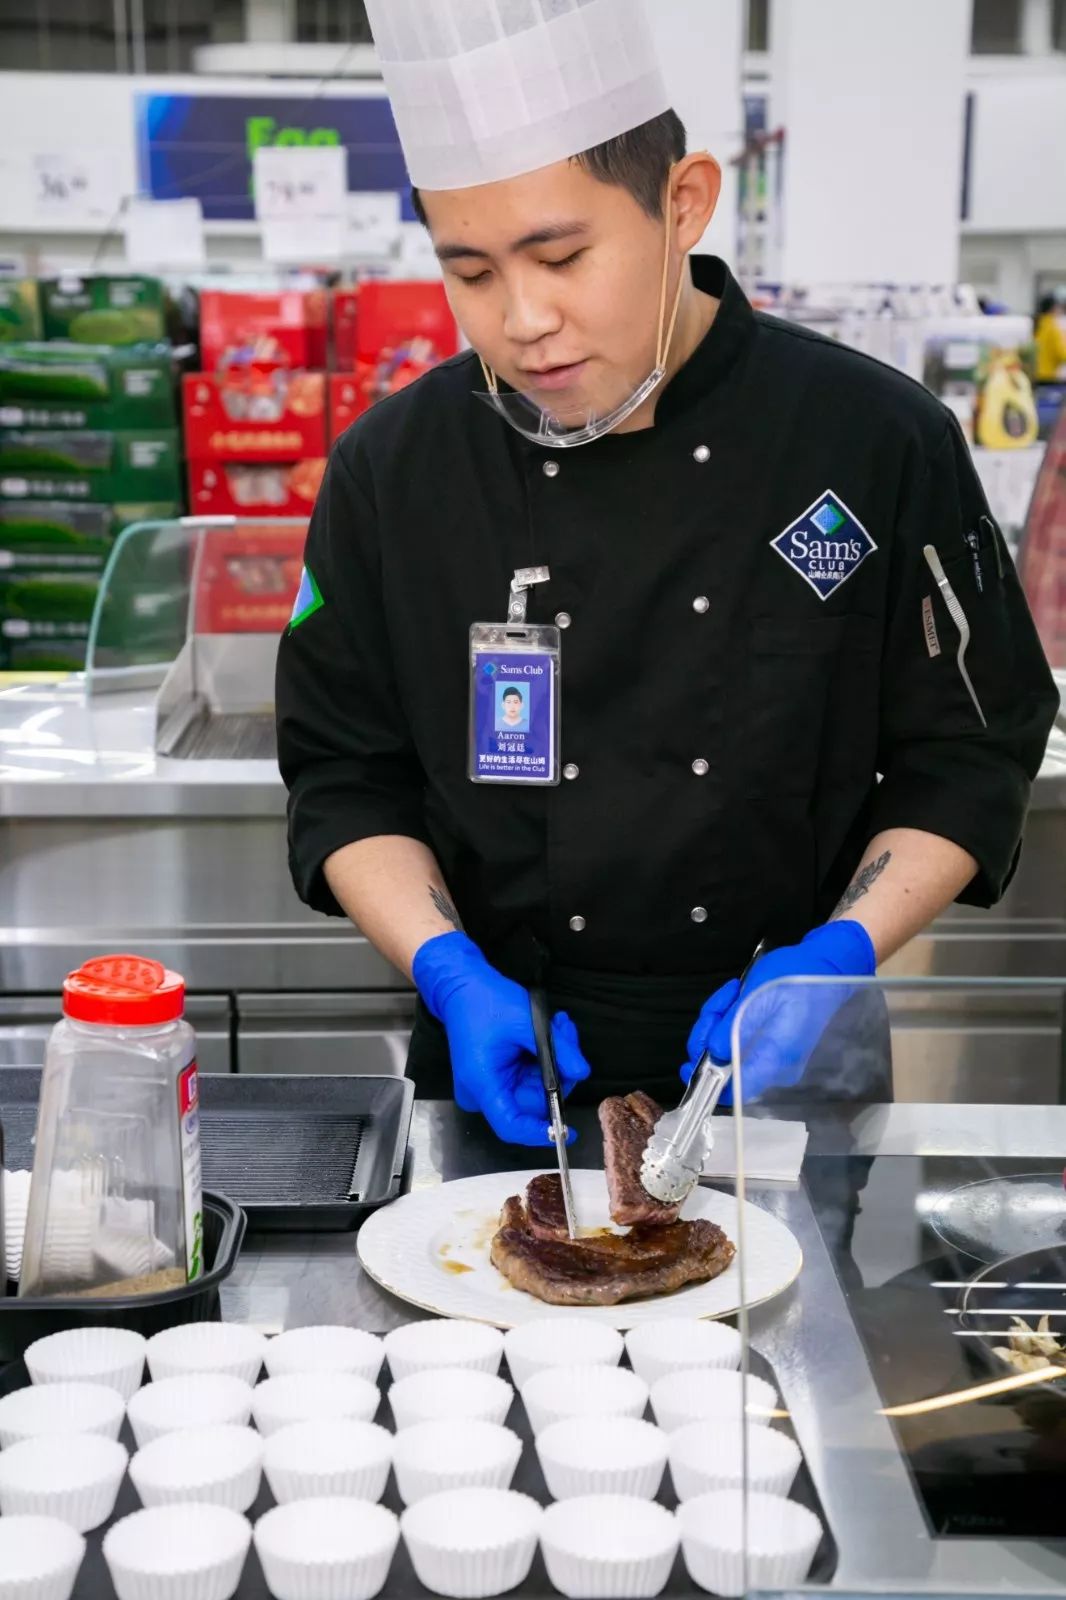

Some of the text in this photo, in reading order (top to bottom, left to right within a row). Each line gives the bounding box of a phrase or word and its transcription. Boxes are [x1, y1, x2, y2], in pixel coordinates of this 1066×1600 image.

[790, 530, 862, 561] Sam's
[808, 560, 845, 571] CLUB
[523, 665, 544, 675] Club
[498, 731, 525, 740] Aaron
[479, 755, 546, 765] 更好的生活尽在山姆
[532, 765, 546, 773] Club
